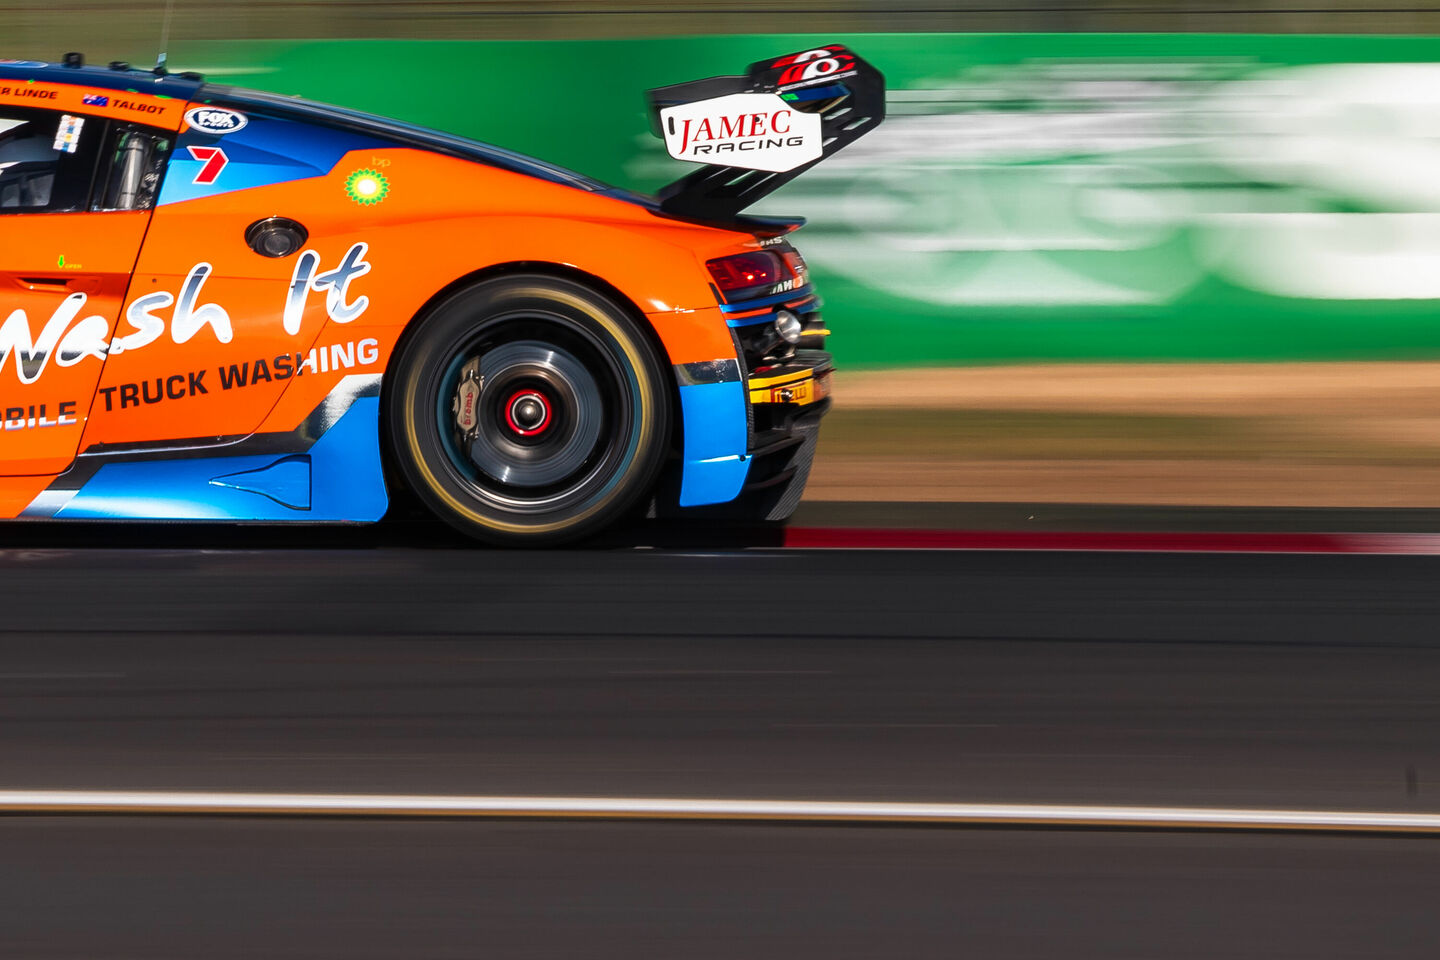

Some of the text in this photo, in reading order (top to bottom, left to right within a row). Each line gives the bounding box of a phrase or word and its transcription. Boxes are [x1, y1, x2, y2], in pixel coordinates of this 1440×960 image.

[14, 88, 58, 99] LINDE
[112, 99, 167, 115] TALBOT
[198, 111, 234, 125] FOX
[678, 110, 792, 155] JAMEC
[693, 136, 804, 155] RACING
[186, 145, 229, 184] 7
[282, 242, 372, 335] It
[99, 369, 209, 412] TRUCK
[218, 337, 379, 391] WASHING
